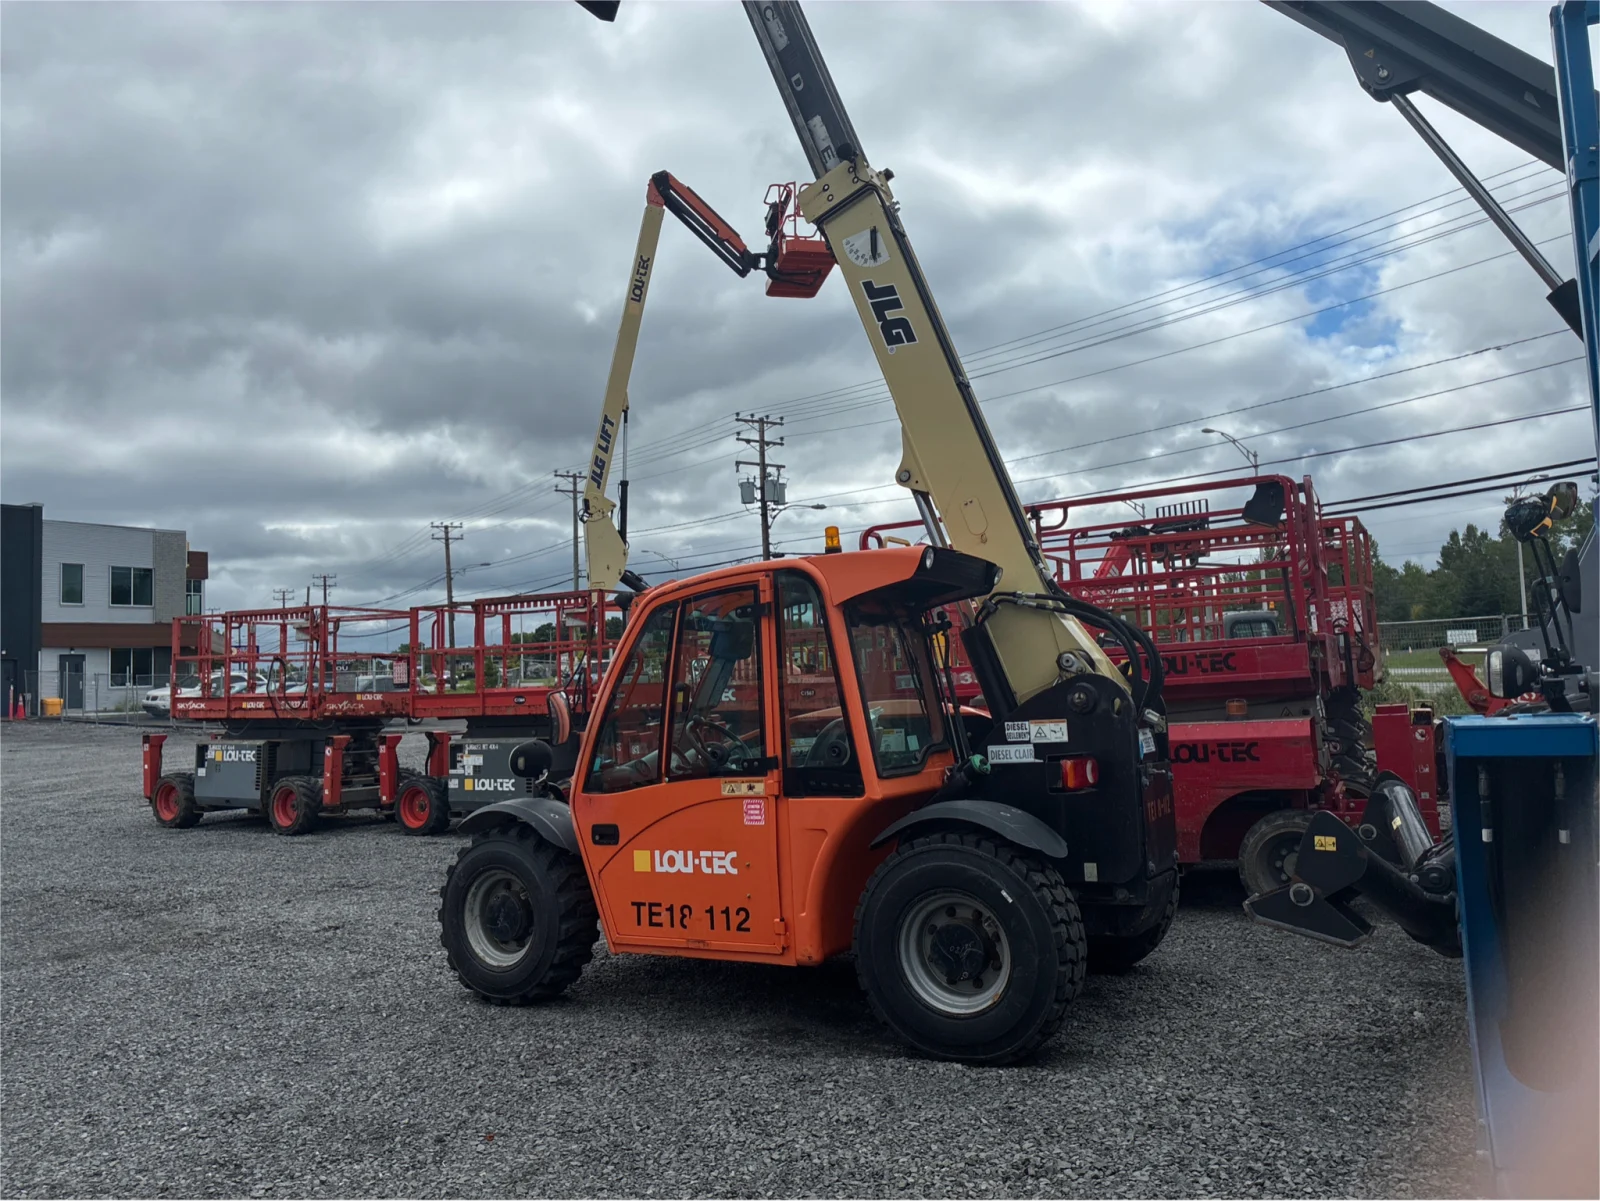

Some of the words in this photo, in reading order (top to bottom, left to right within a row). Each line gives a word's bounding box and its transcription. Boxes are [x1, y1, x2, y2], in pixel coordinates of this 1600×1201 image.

[791, 72, 804, 92] D
[821, 144, 836, 164] E
[860, 279, 918, 348] JLG
[589, 455, 606, 490] JLG
[598, 414, 615, 453] LIFT
[177, 700, 205, 710] SKYJACK
[326, 700, 365, 711] SKYJACK
[1006, 722, 1028, 731] DIESEL
[990, 750, 1013, 760] DIESEL
[1014, 748, 1034, 760] CLAIR
[704, 905, 751, 932] 112
